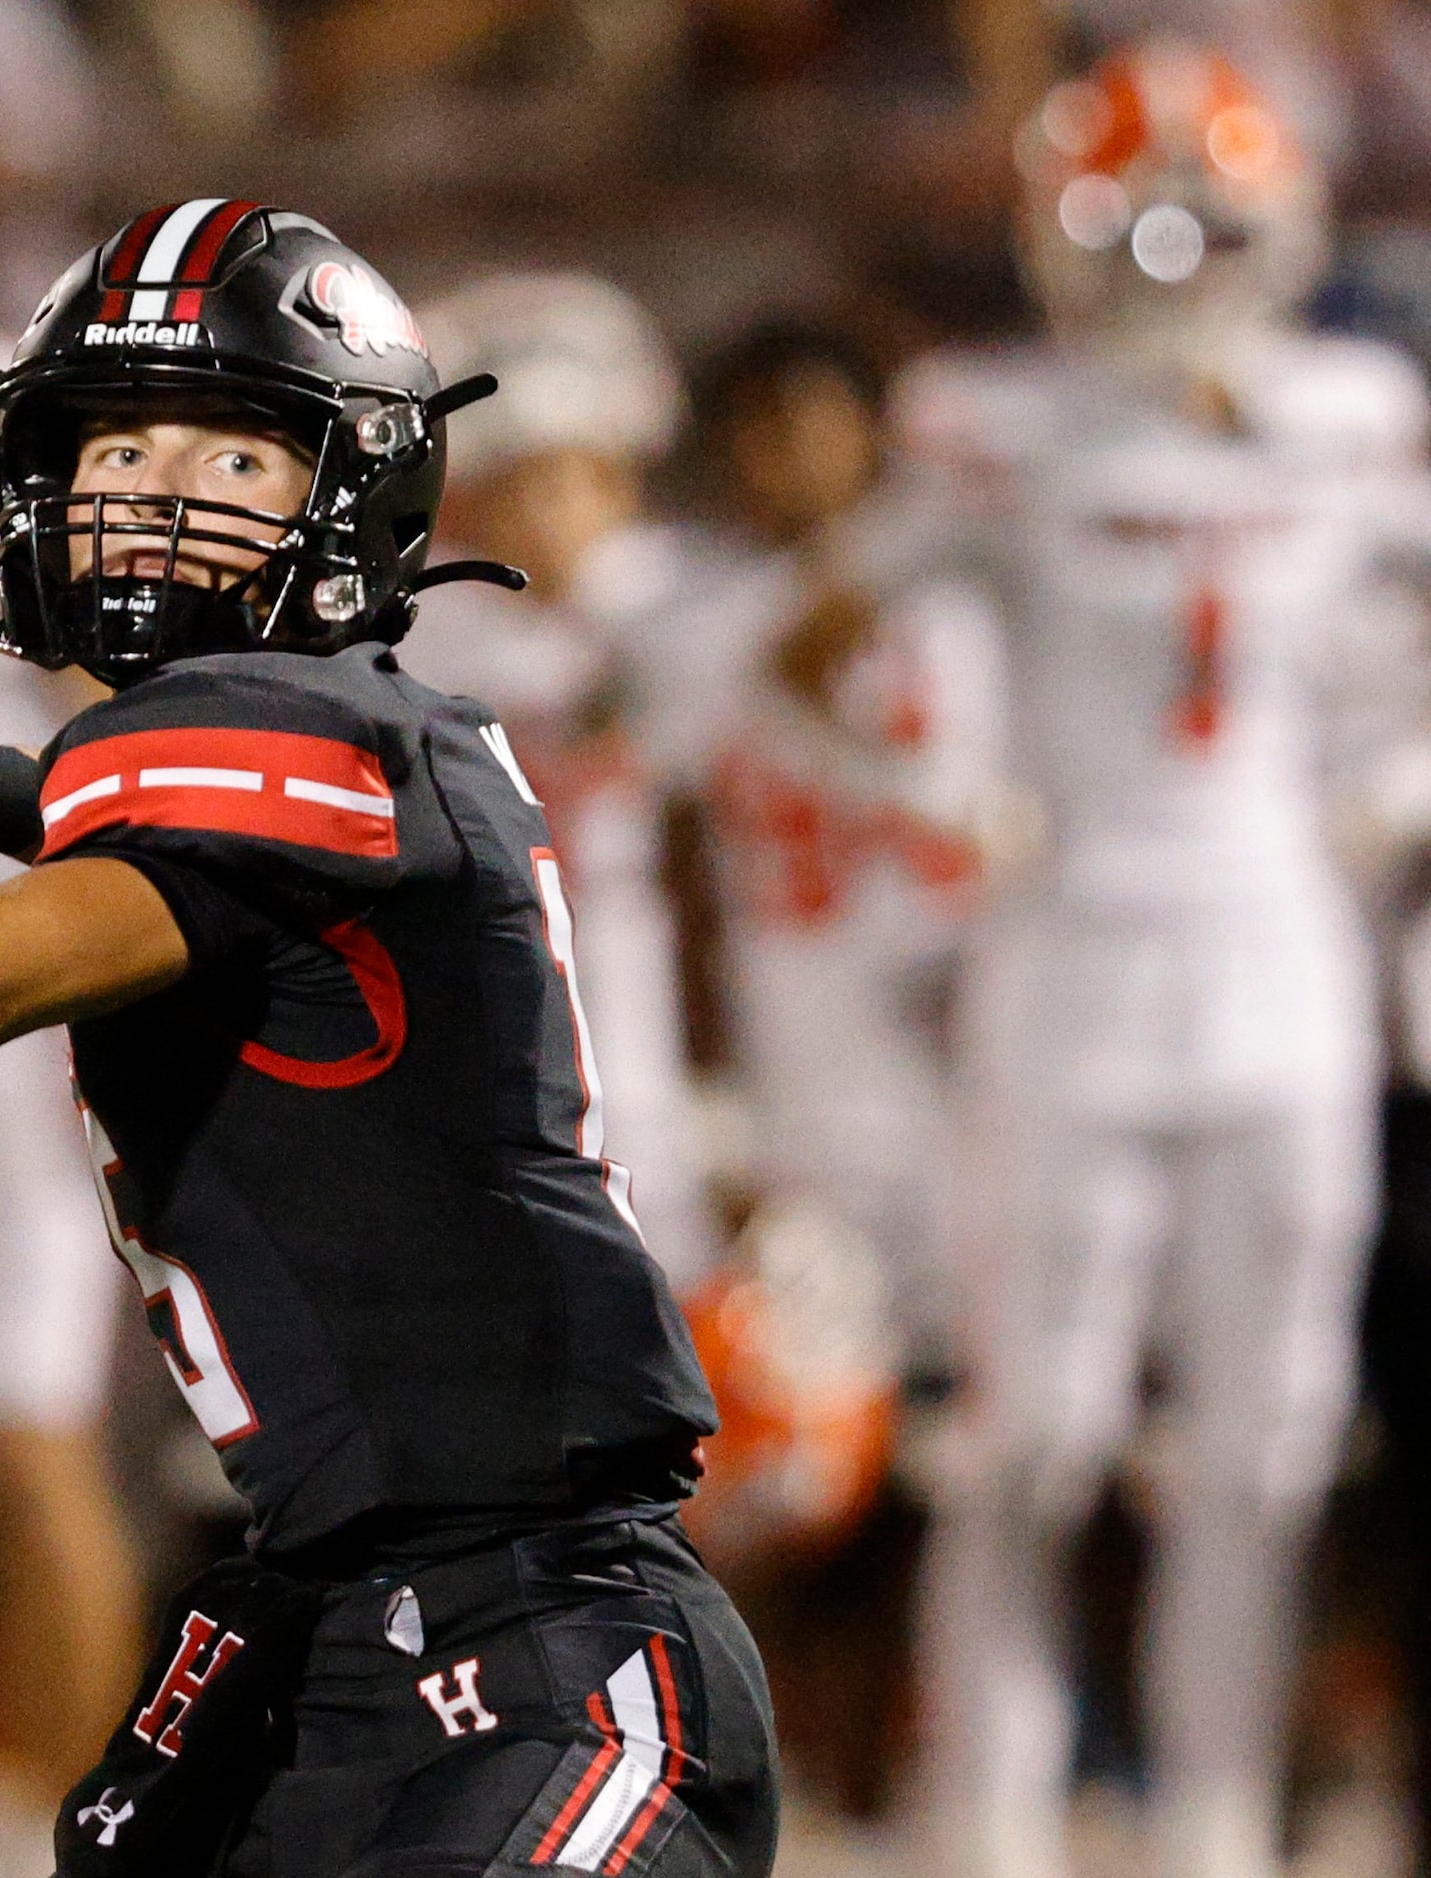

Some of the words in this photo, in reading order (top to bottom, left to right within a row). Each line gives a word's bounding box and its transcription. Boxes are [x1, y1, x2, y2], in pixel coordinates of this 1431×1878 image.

[84, 321, 199, 346] Riddell
[101, 596, 156, 614] Ridell
[132, 1610, 245, 1758] H
[415, 1656, 502, 1737] H
